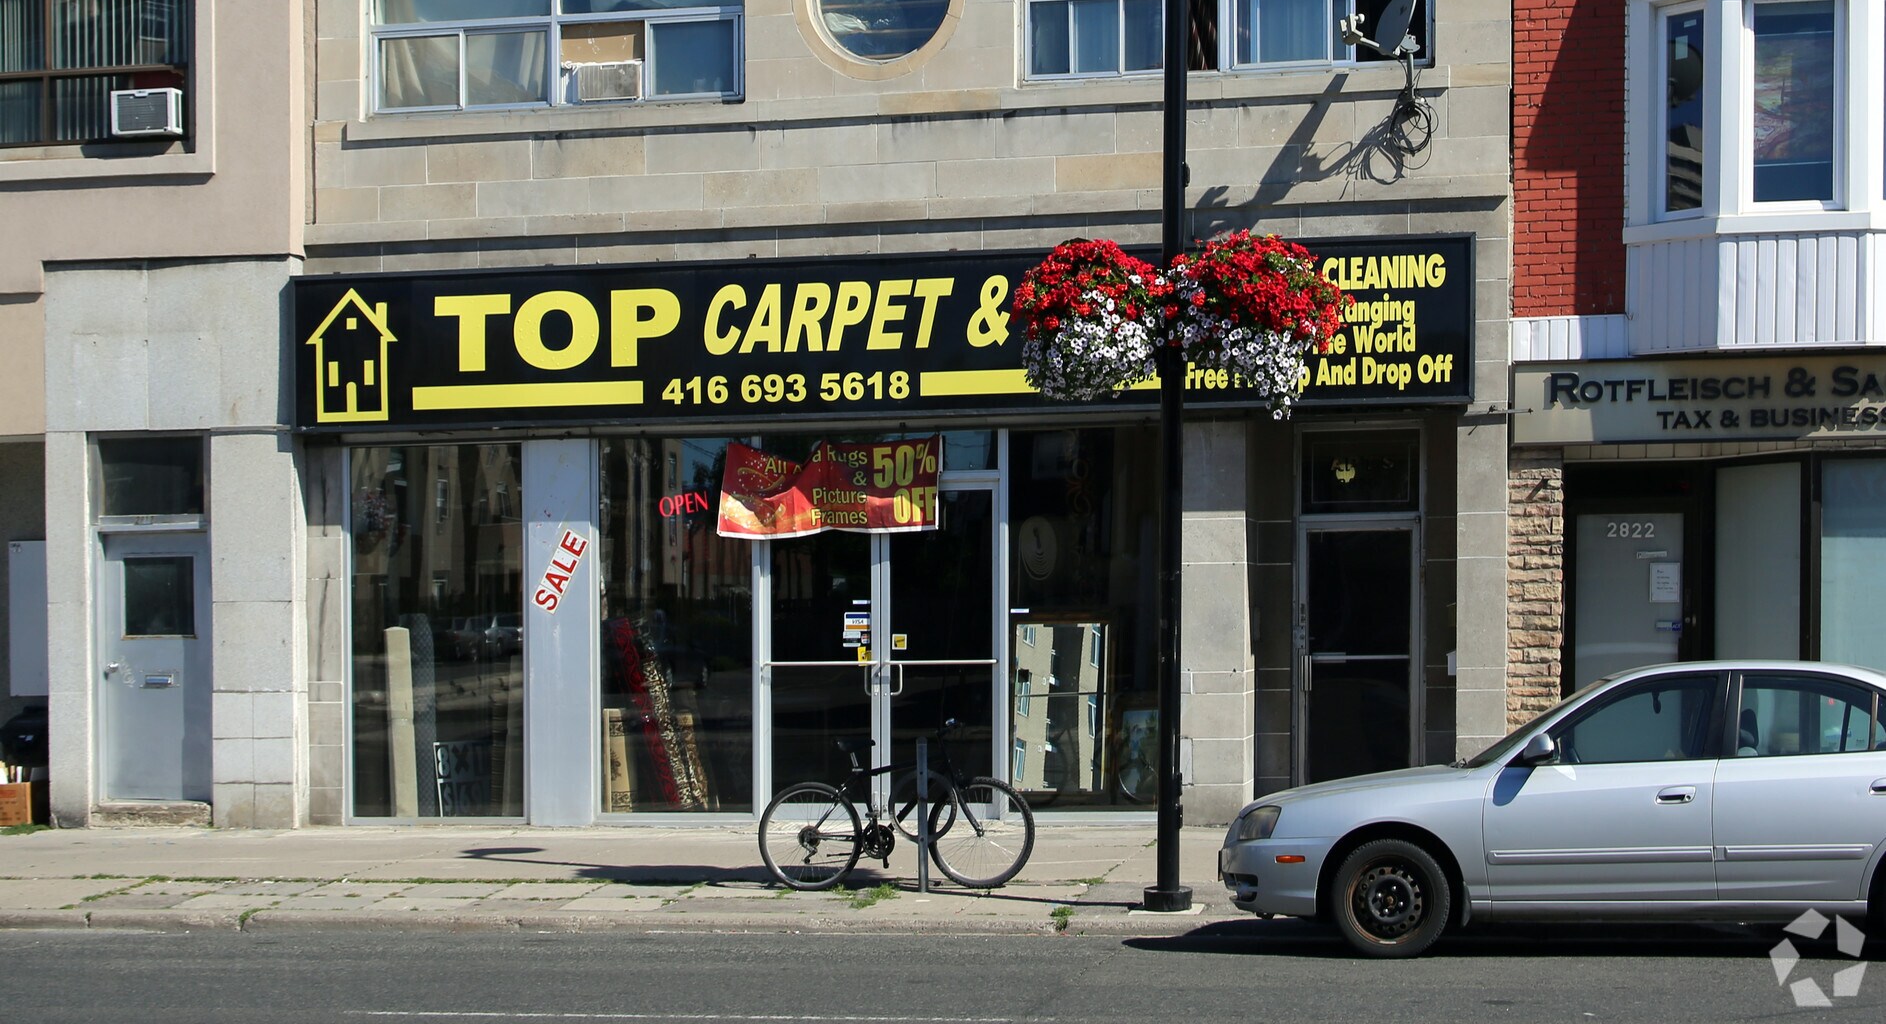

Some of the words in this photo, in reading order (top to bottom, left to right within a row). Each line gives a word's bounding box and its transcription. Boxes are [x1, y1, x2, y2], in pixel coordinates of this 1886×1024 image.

[1322, 253, 1447, 290] CLEANING
[434, 288, 681, 372] TOP
[703, 277, 955, 356] CARPET
[966, 274, 1011, 348] &
[1338, 292, 1416, 328] anging
[1353, 322, 1416, 354] World
[662, 375, 728, 404] 416
[741, 373, 807, 403] 693
[820, 370, 910, 401] 5618
[1184, 361, 1229, 390] Free
[1316, 357, 1356, 386] And
[1362, 357, 1412, 390] Drop
[1418, 353, 1454, 383] Off
[1550, 372, 1771, 403] ROTFLEISCH
[1784, 366, 1816, 398] &
[1831, 365, 1886, 397] SA
[1656, 410, 1712, 430] TAX
[1719, 409, 1739, 428] &
[765, 456, 787, 474] All
[827, 444, 868, 468] Rugs
[873, 441, 936, 488] 50%
[852, 470, 867, 486] &
[658, 491, 709, 517] OPEN
[812, 488, 868, 505] Picture
[893, 486, 937, 524] OFF
[810, 508, 868, 526] Frames
[1607, 522, 1655, 538] 2822
[535, 531, 588, 611] SALE
